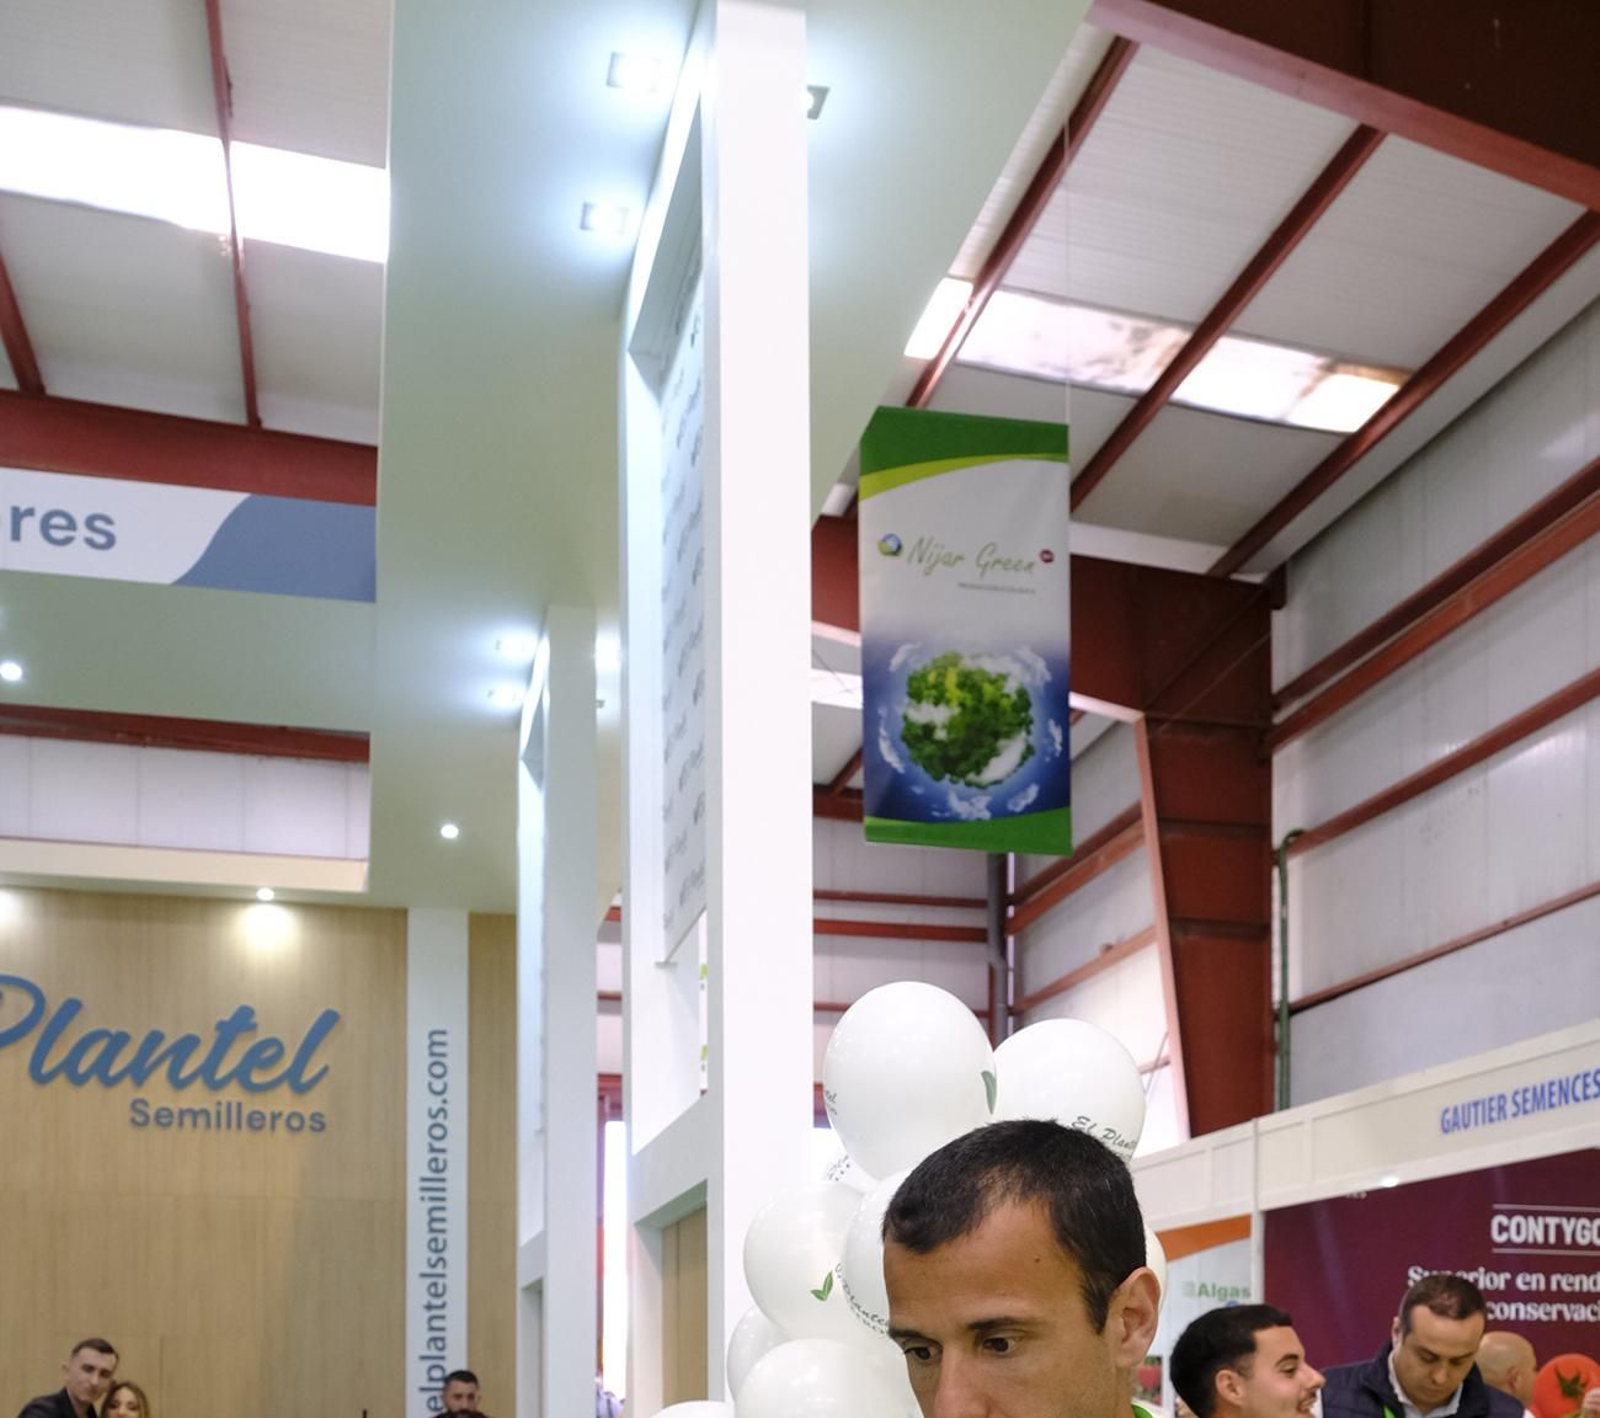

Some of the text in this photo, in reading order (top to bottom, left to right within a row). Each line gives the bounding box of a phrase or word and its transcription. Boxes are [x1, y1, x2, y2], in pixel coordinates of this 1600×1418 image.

[0, 505, 117, 551] res
[974, 541, 1035, 578] Green
[129, 1098, 327, 1133] Semilleros
[1440, 1068, 1600, 1135] GAUTIER SEMENCES
[418, 1028, 449, 1412] elplantelsemilleros.com
[1197, 1282, 1251, 1300] Algas
[1515, 1271, 1546, 1291] en
